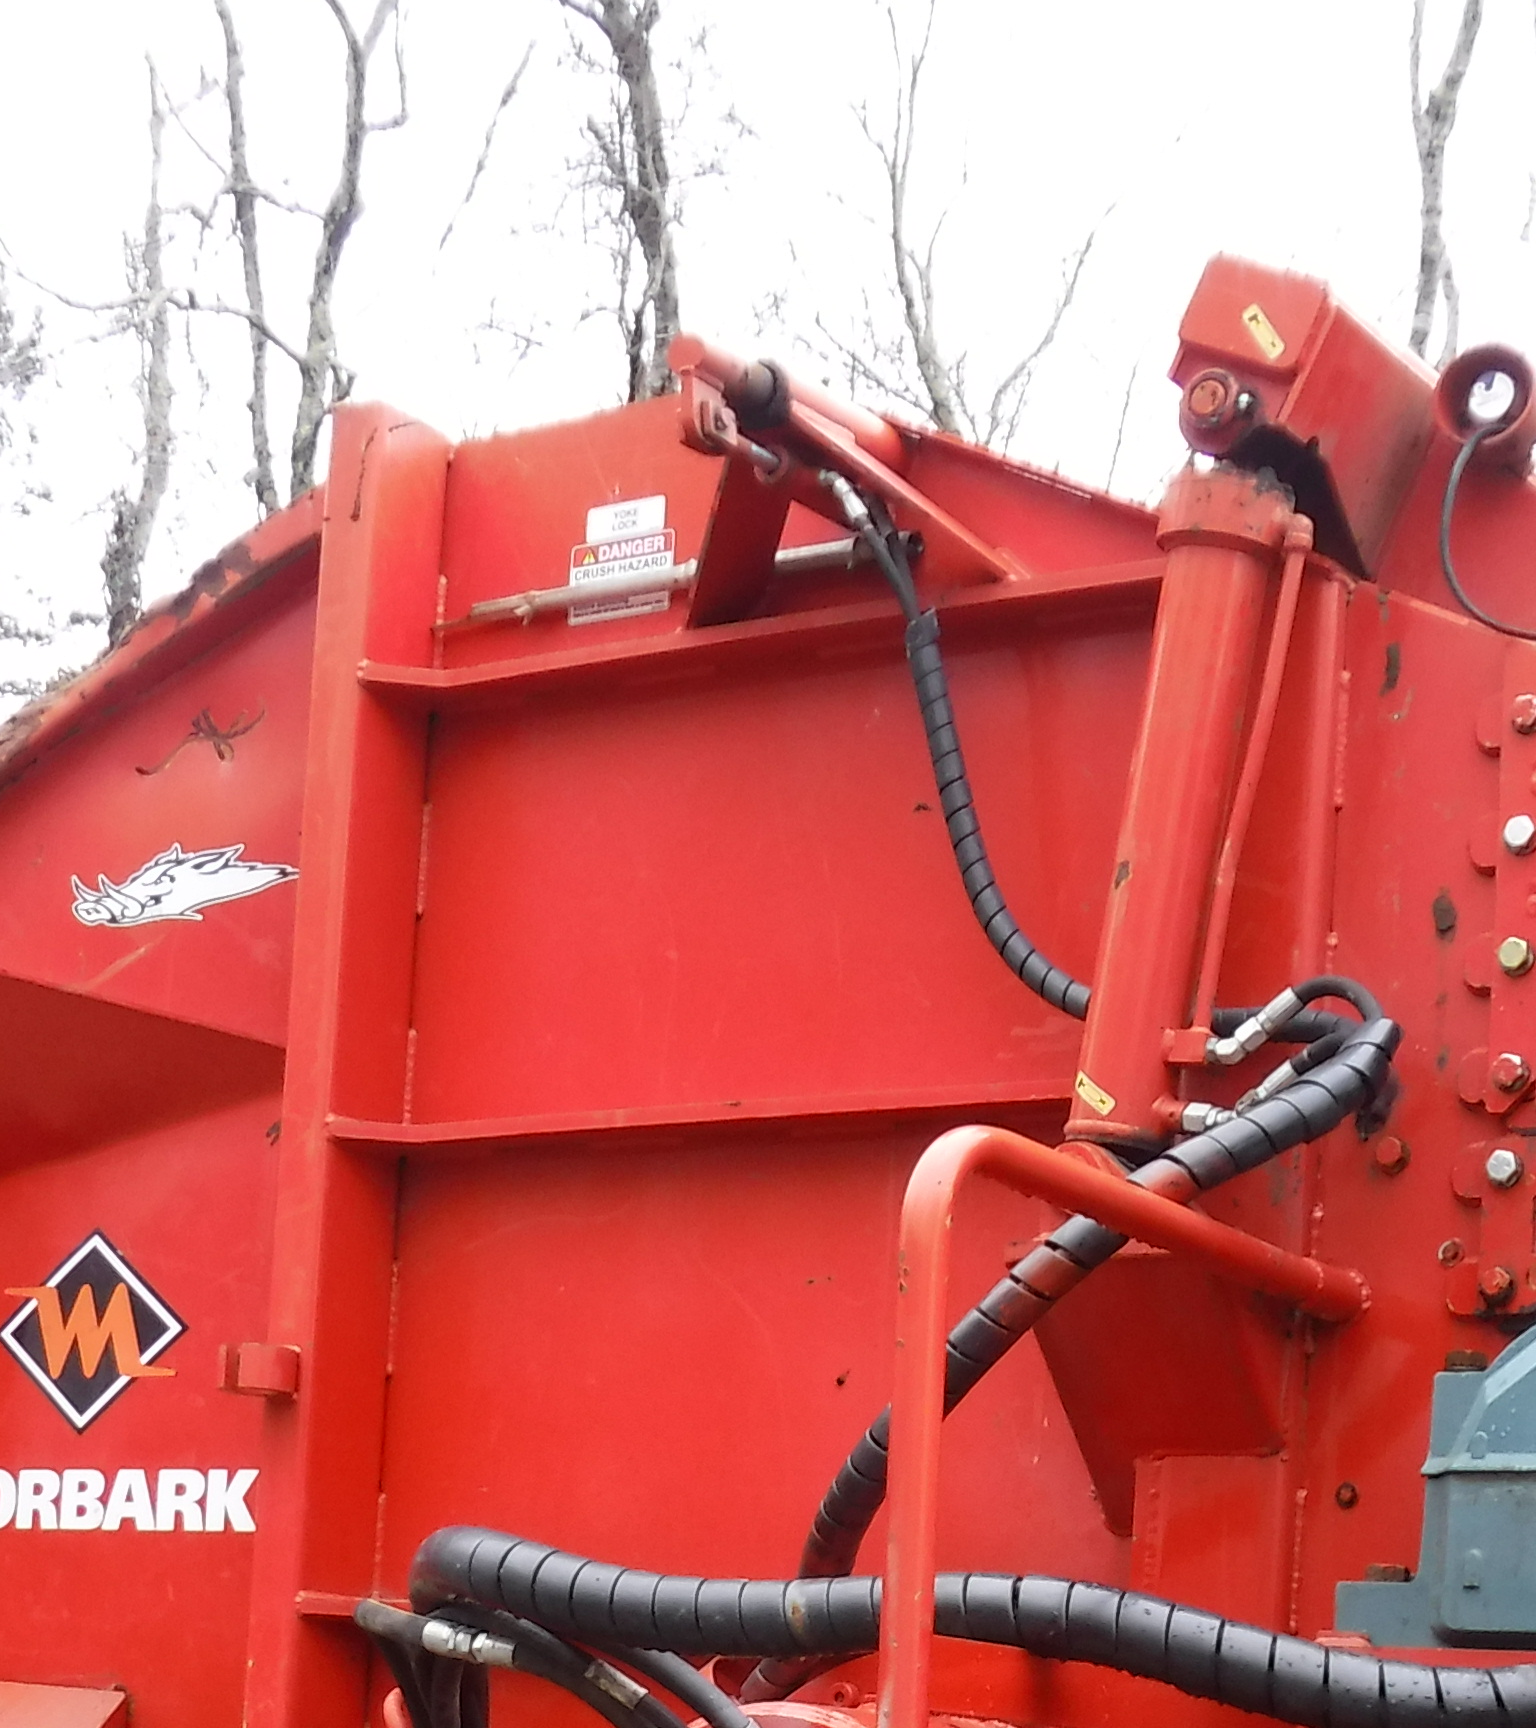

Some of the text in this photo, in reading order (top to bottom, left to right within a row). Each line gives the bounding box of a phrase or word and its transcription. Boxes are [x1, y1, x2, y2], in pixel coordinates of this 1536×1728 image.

[598, 534, 666, 562] DANGER
[574, 554, 669, 581] CRUSH HAZARD
